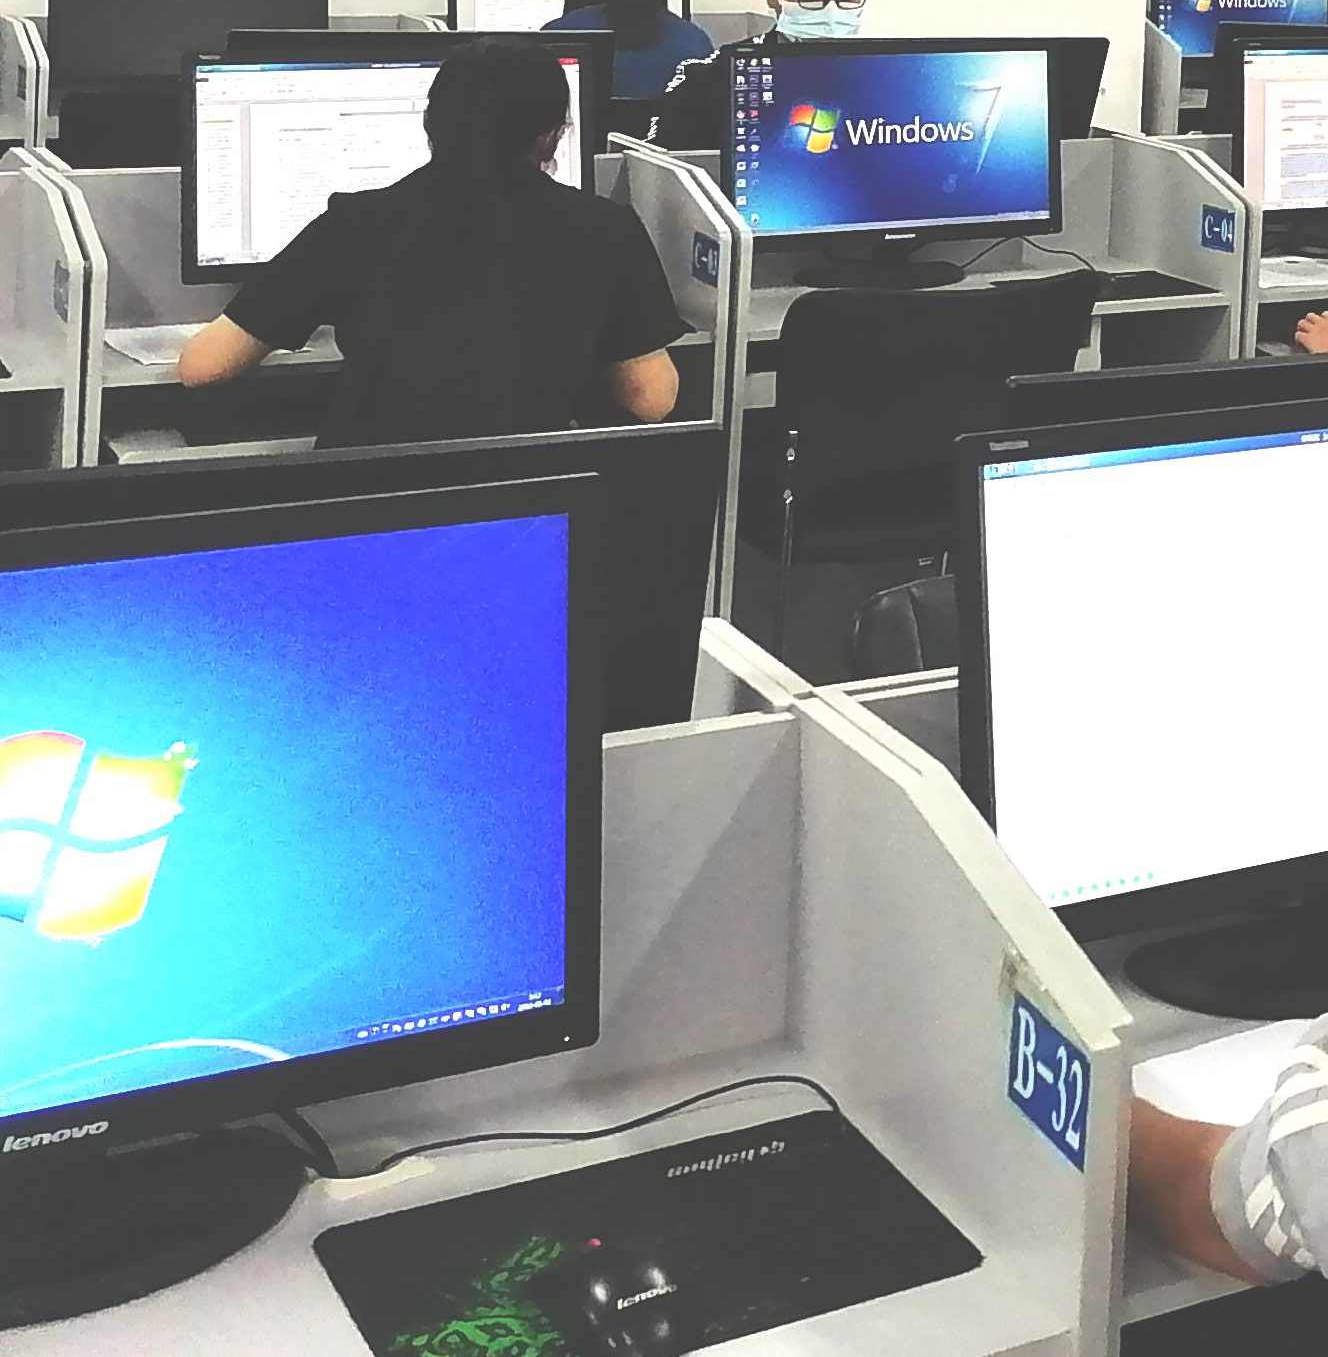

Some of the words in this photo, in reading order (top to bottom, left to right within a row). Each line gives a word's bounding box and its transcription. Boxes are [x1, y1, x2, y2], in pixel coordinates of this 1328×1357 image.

[846, 116, 975, 146] Windows
[1013, 1006, 1083, 1151] B-32
[2, 1121, 109, 1153] lenovo
[616, 1283, 677, 1310] lenovo
